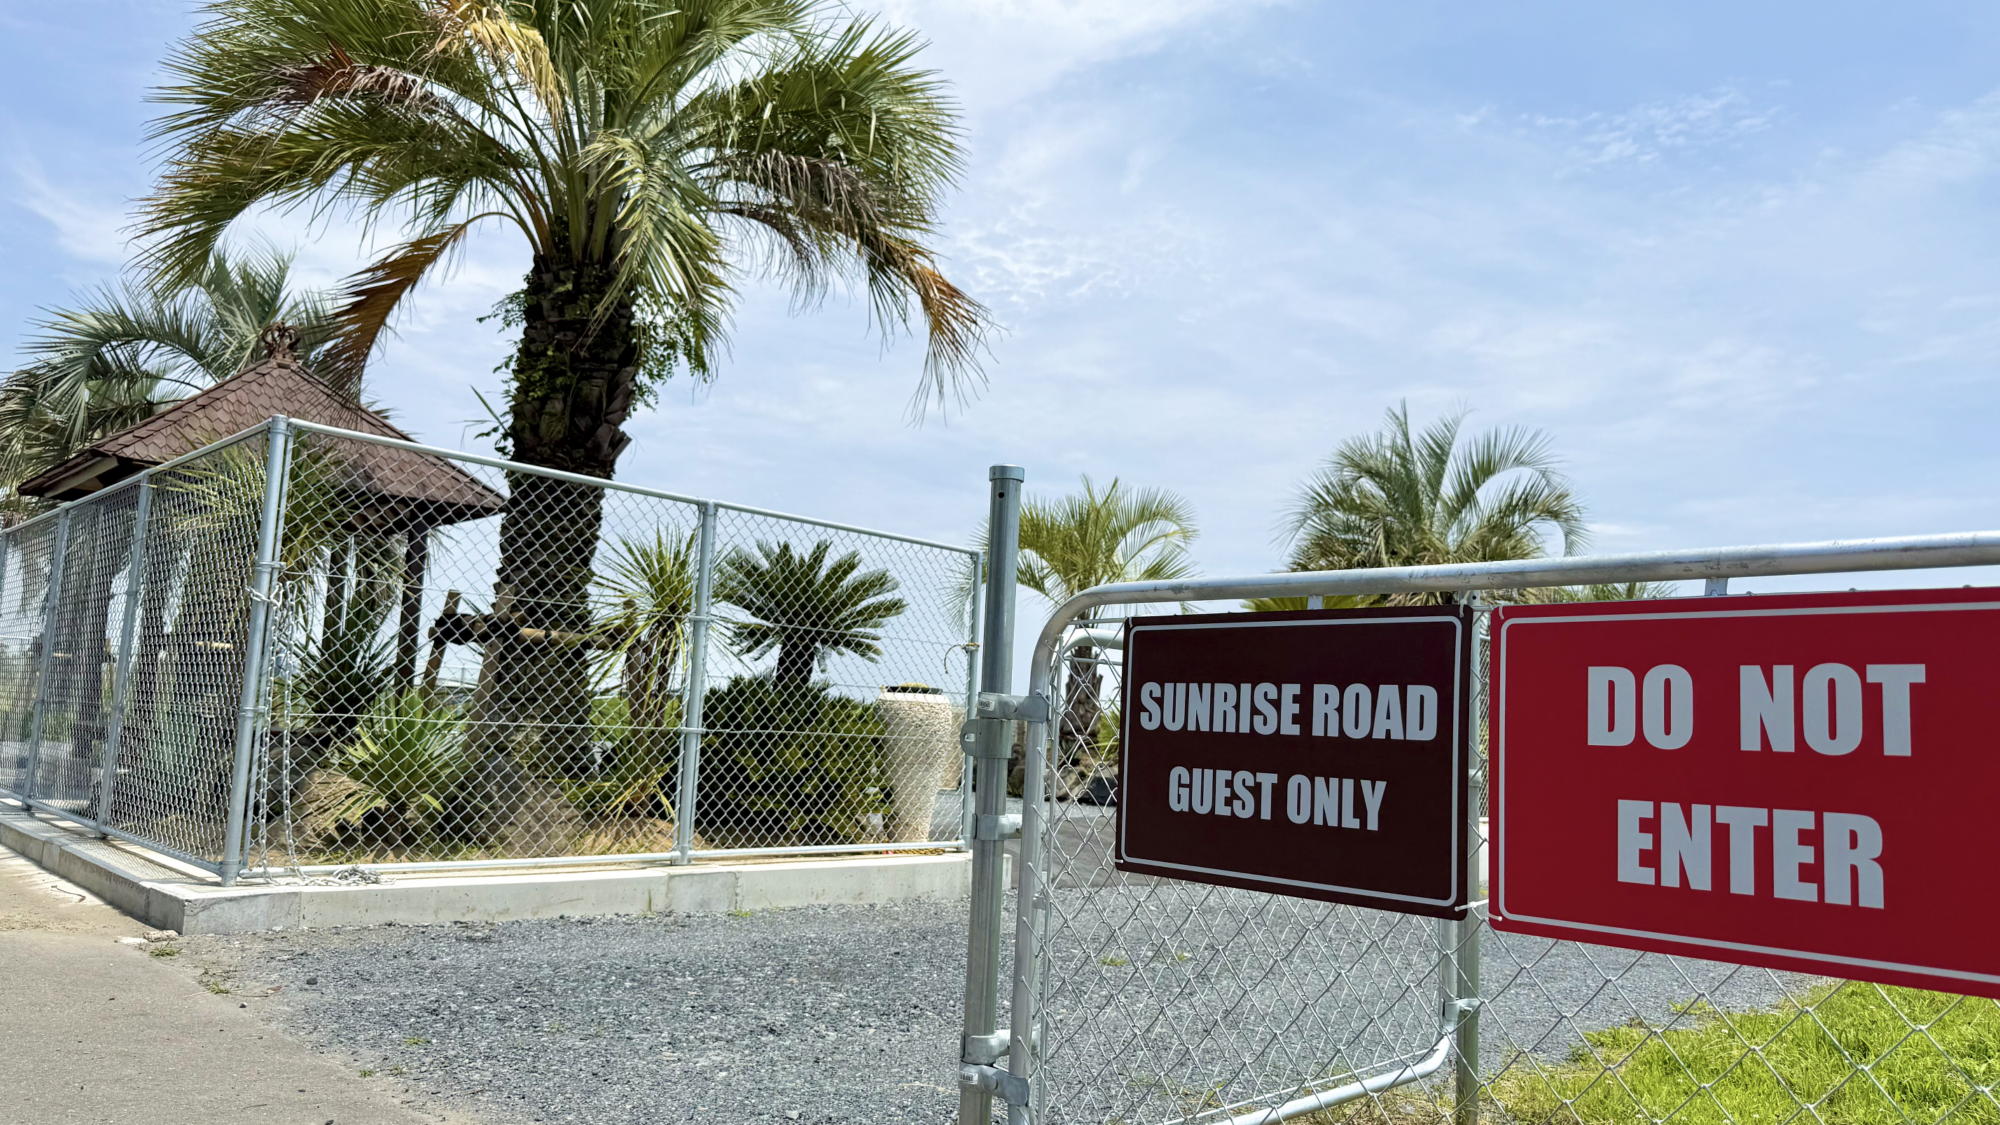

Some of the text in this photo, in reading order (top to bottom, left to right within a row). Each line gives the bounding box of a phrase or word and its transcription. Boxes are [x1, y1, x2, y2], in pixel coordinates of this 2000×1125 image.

[1140, 681, 1438, 741] SUNRISE ROAD
[1588, 662, 1926, 757] DO NOT
[1168, 766, 1387, 832] GUEST ONLY
[1617, 799, 1885, 910] ENTER
